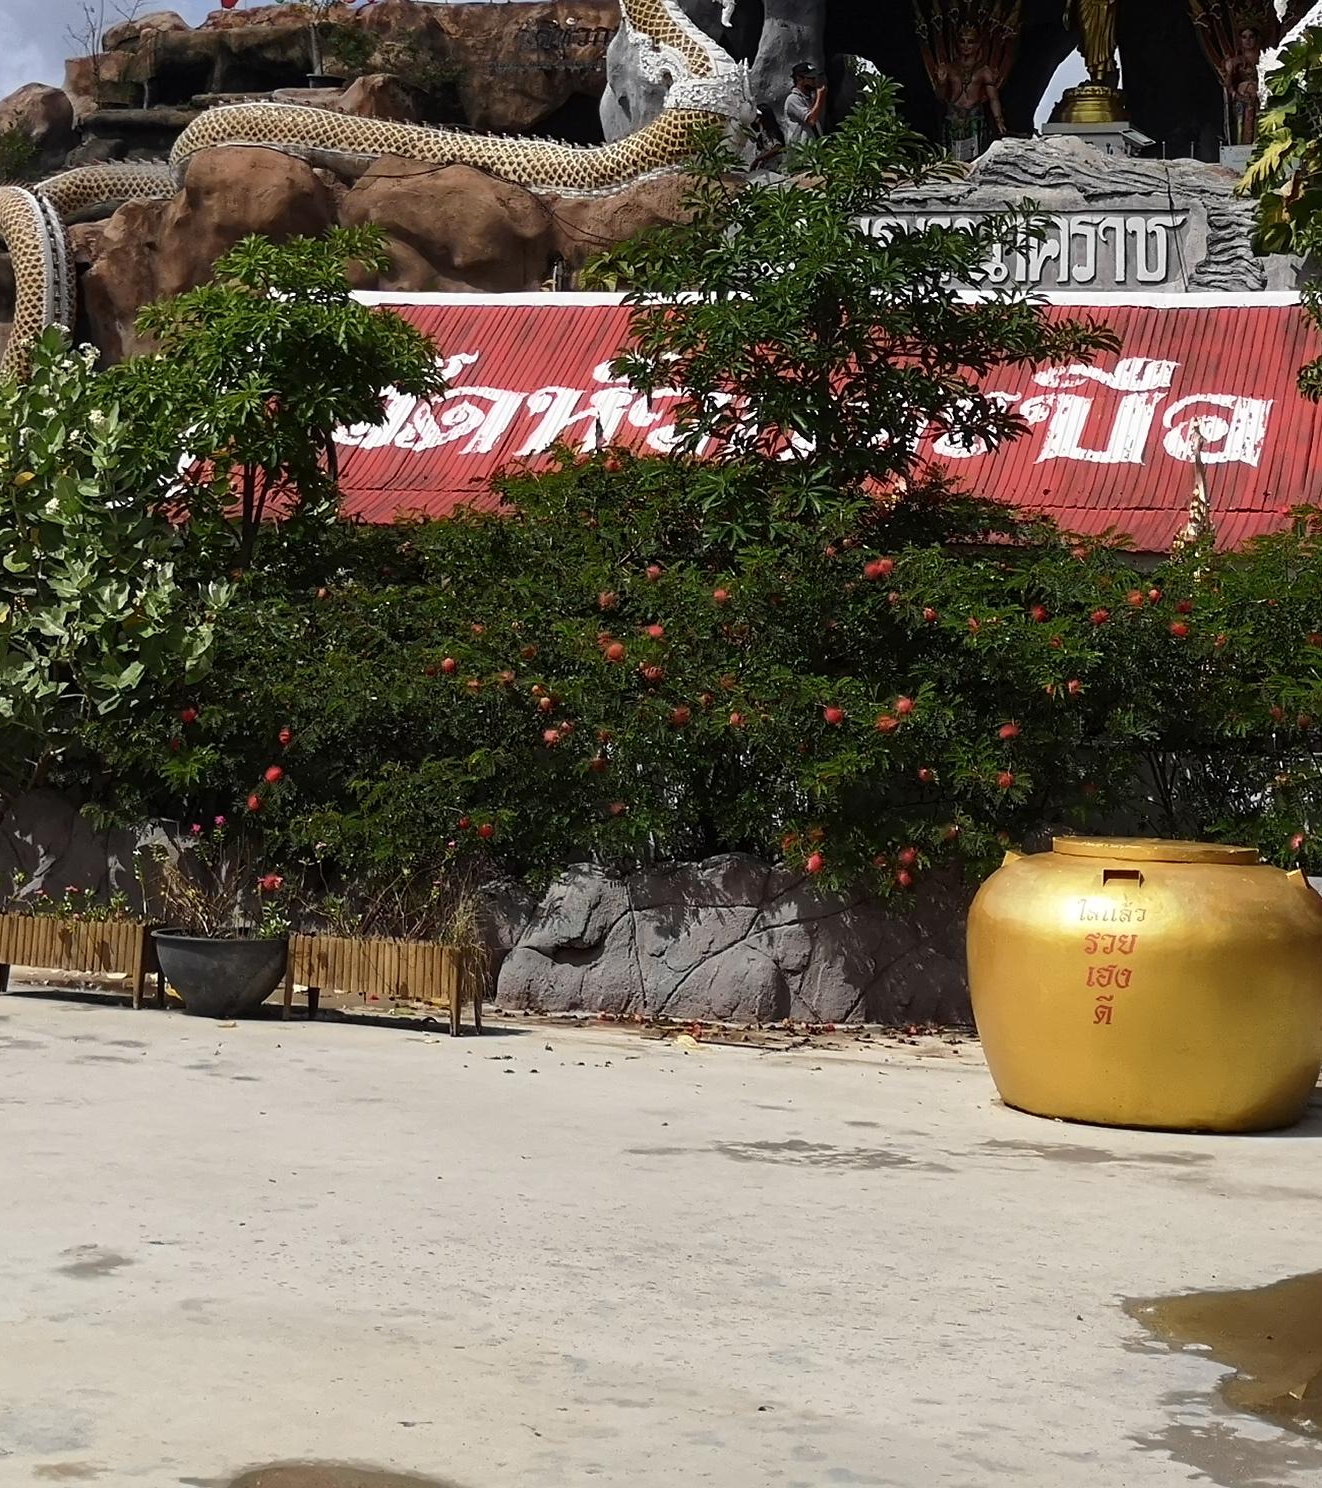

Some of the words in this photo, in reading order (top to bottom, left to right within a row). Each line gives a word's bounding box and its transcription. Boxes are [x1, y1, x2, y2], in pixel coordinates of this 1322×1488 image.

[1084, 932, 1138, 956] รวย
[1085, 964, 1133, 989] เฮง
[1092, 994, 1114, 1025] ดี
